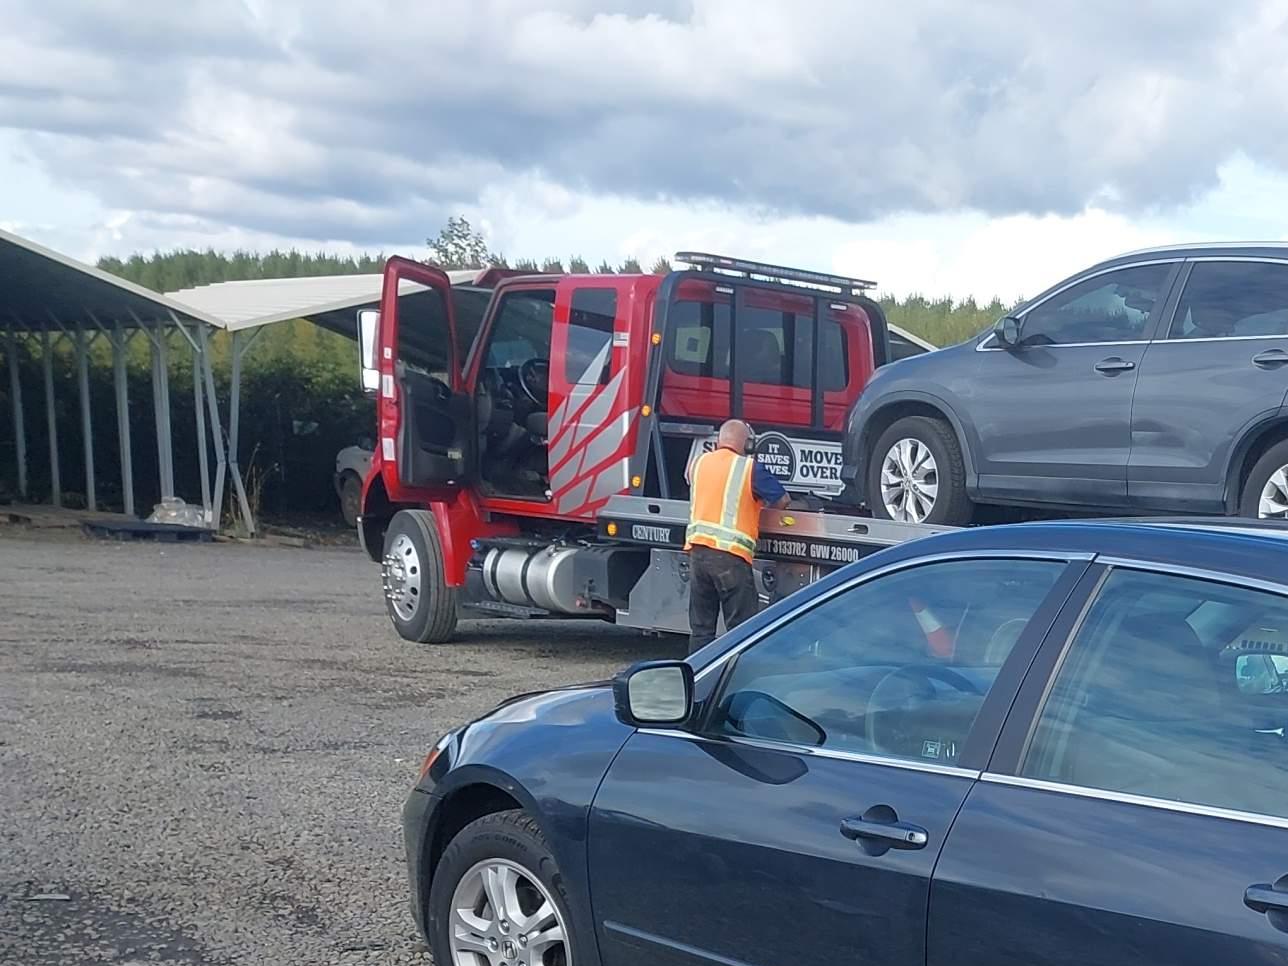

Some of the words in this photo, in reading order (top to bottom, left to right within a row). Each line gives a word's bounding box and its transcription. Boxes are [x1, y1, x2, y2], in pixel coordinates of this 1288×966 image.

[768, 443, 780, 454] IT
[757, 453, 790, 465] SAVES
[800, 449, 842, 466] MOVE
[800, 464, 839, 480] OVER
[632, 524, 671, 543] CENTURY
[810, 543, 830, 560] GVW
[830, 546, 859, 562] 26000
